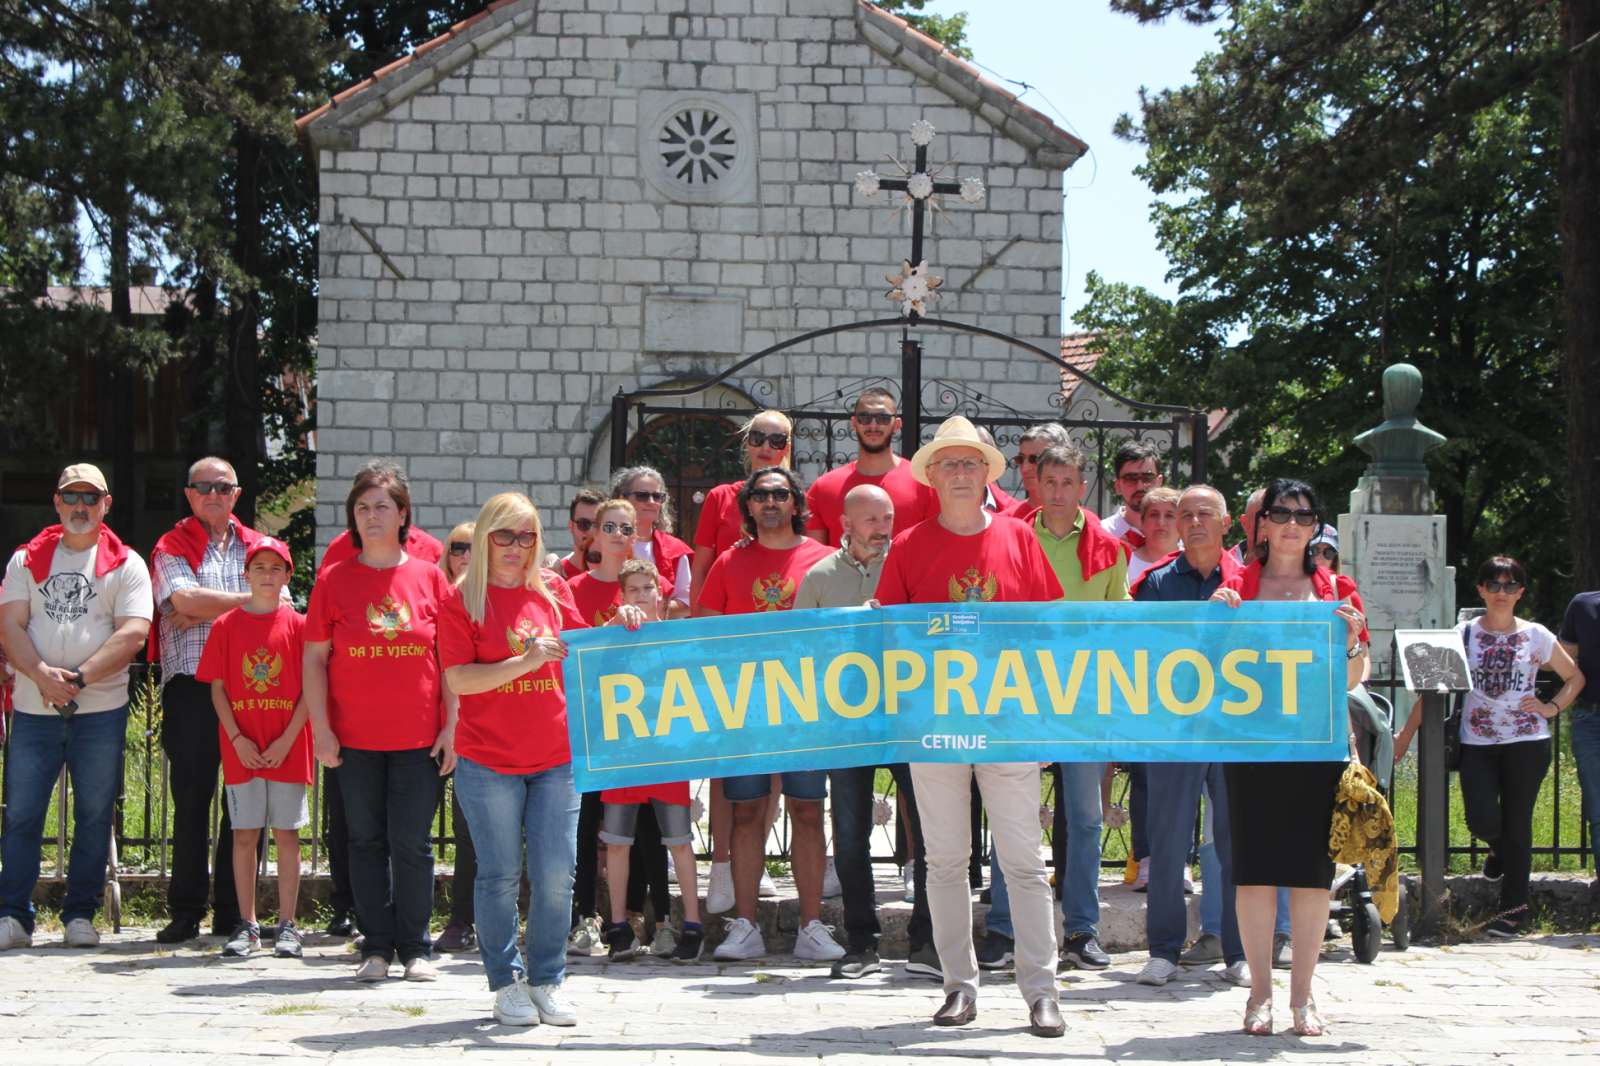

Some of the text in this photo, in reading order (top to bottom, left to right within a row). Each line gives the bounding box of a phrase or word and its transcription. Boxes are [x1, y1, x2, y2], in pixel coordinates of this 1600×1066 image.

[348, 646, 366, 658] DA
[369, 646, 384, 658] JE
[1478, 650, 1516, 669] JUST
[518, 680, 532, 694] JE
[600, 649, 1314, 741] RAVNOPRAVNOST
[921, 735, 988, 749] CETINJE
